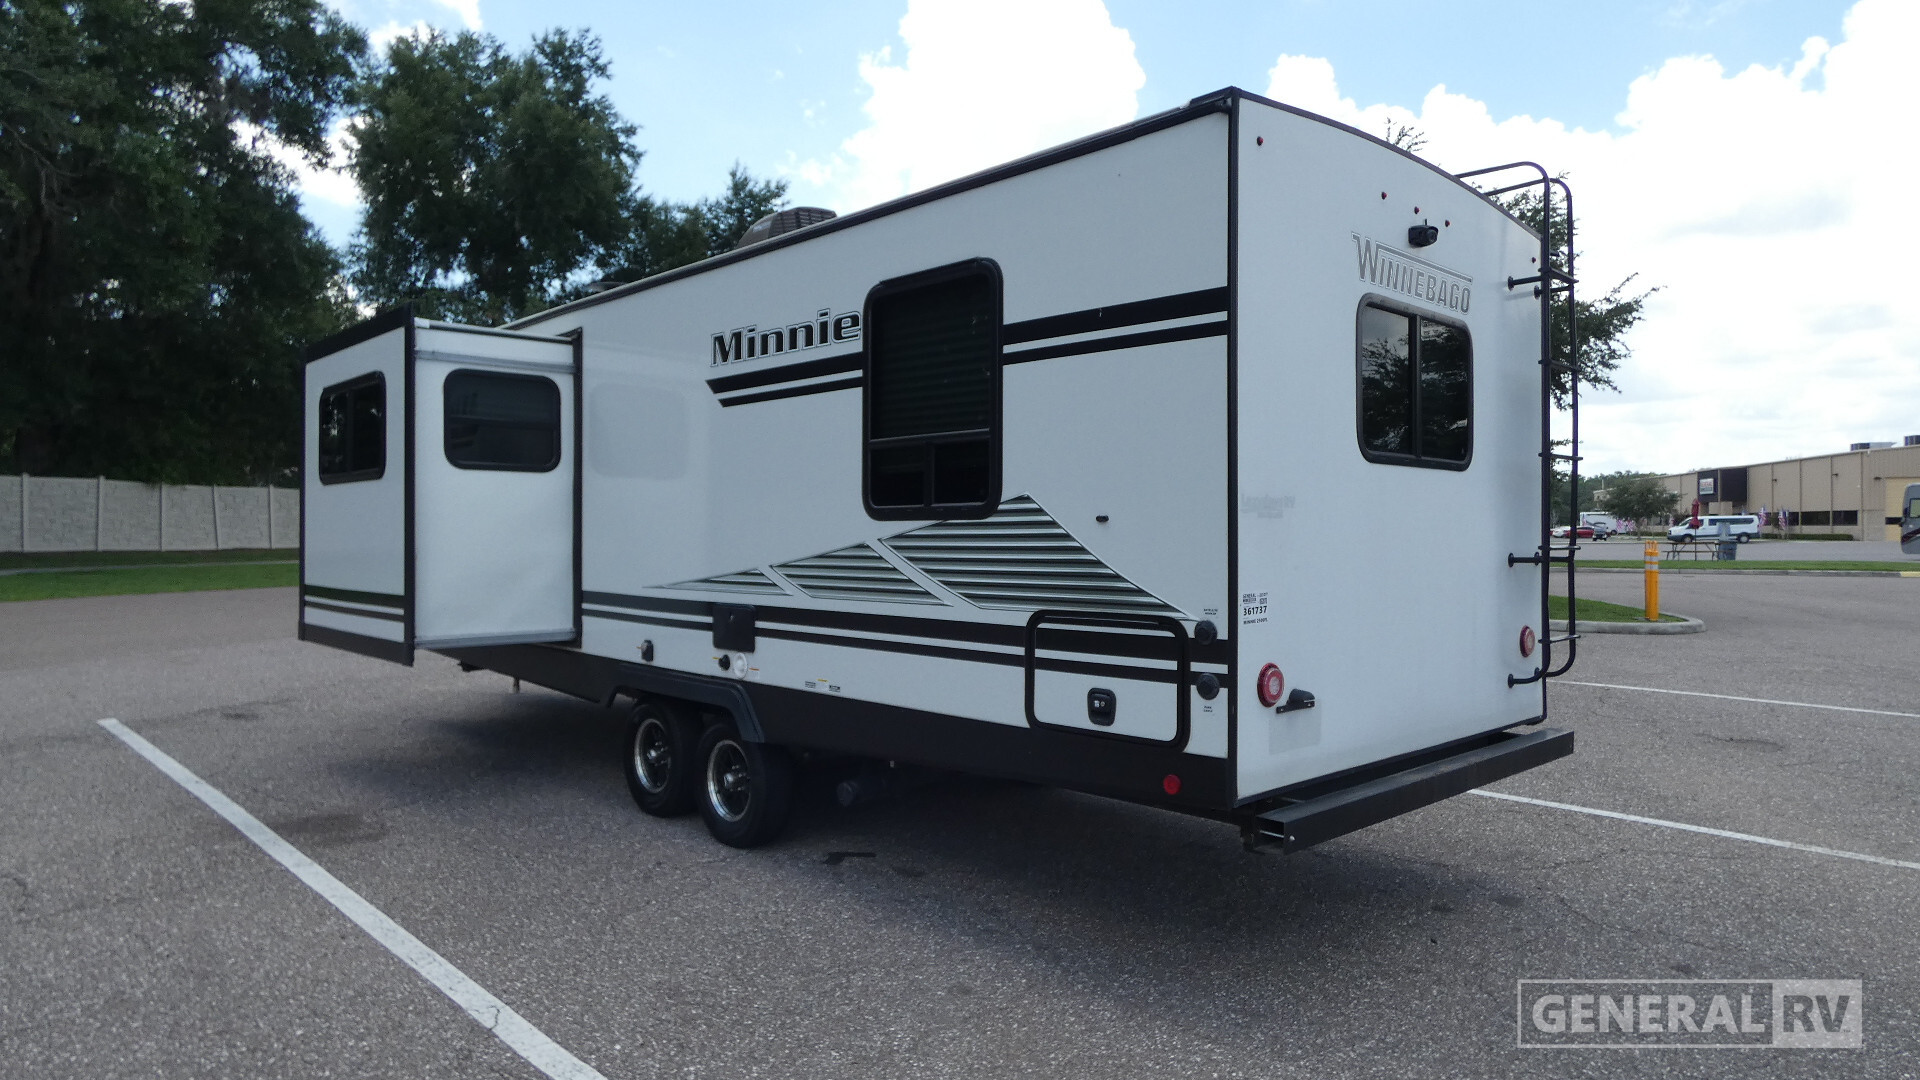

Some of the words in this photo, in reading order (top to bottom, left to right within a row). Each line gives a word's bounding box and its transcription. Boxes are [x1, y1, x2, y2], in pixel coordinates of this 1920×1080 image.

[1351, 231, 1474, 316] WINNEBAGO
[710, 308, 862, 367] Minnie
[1243, 606, 1268, 616] 361737
